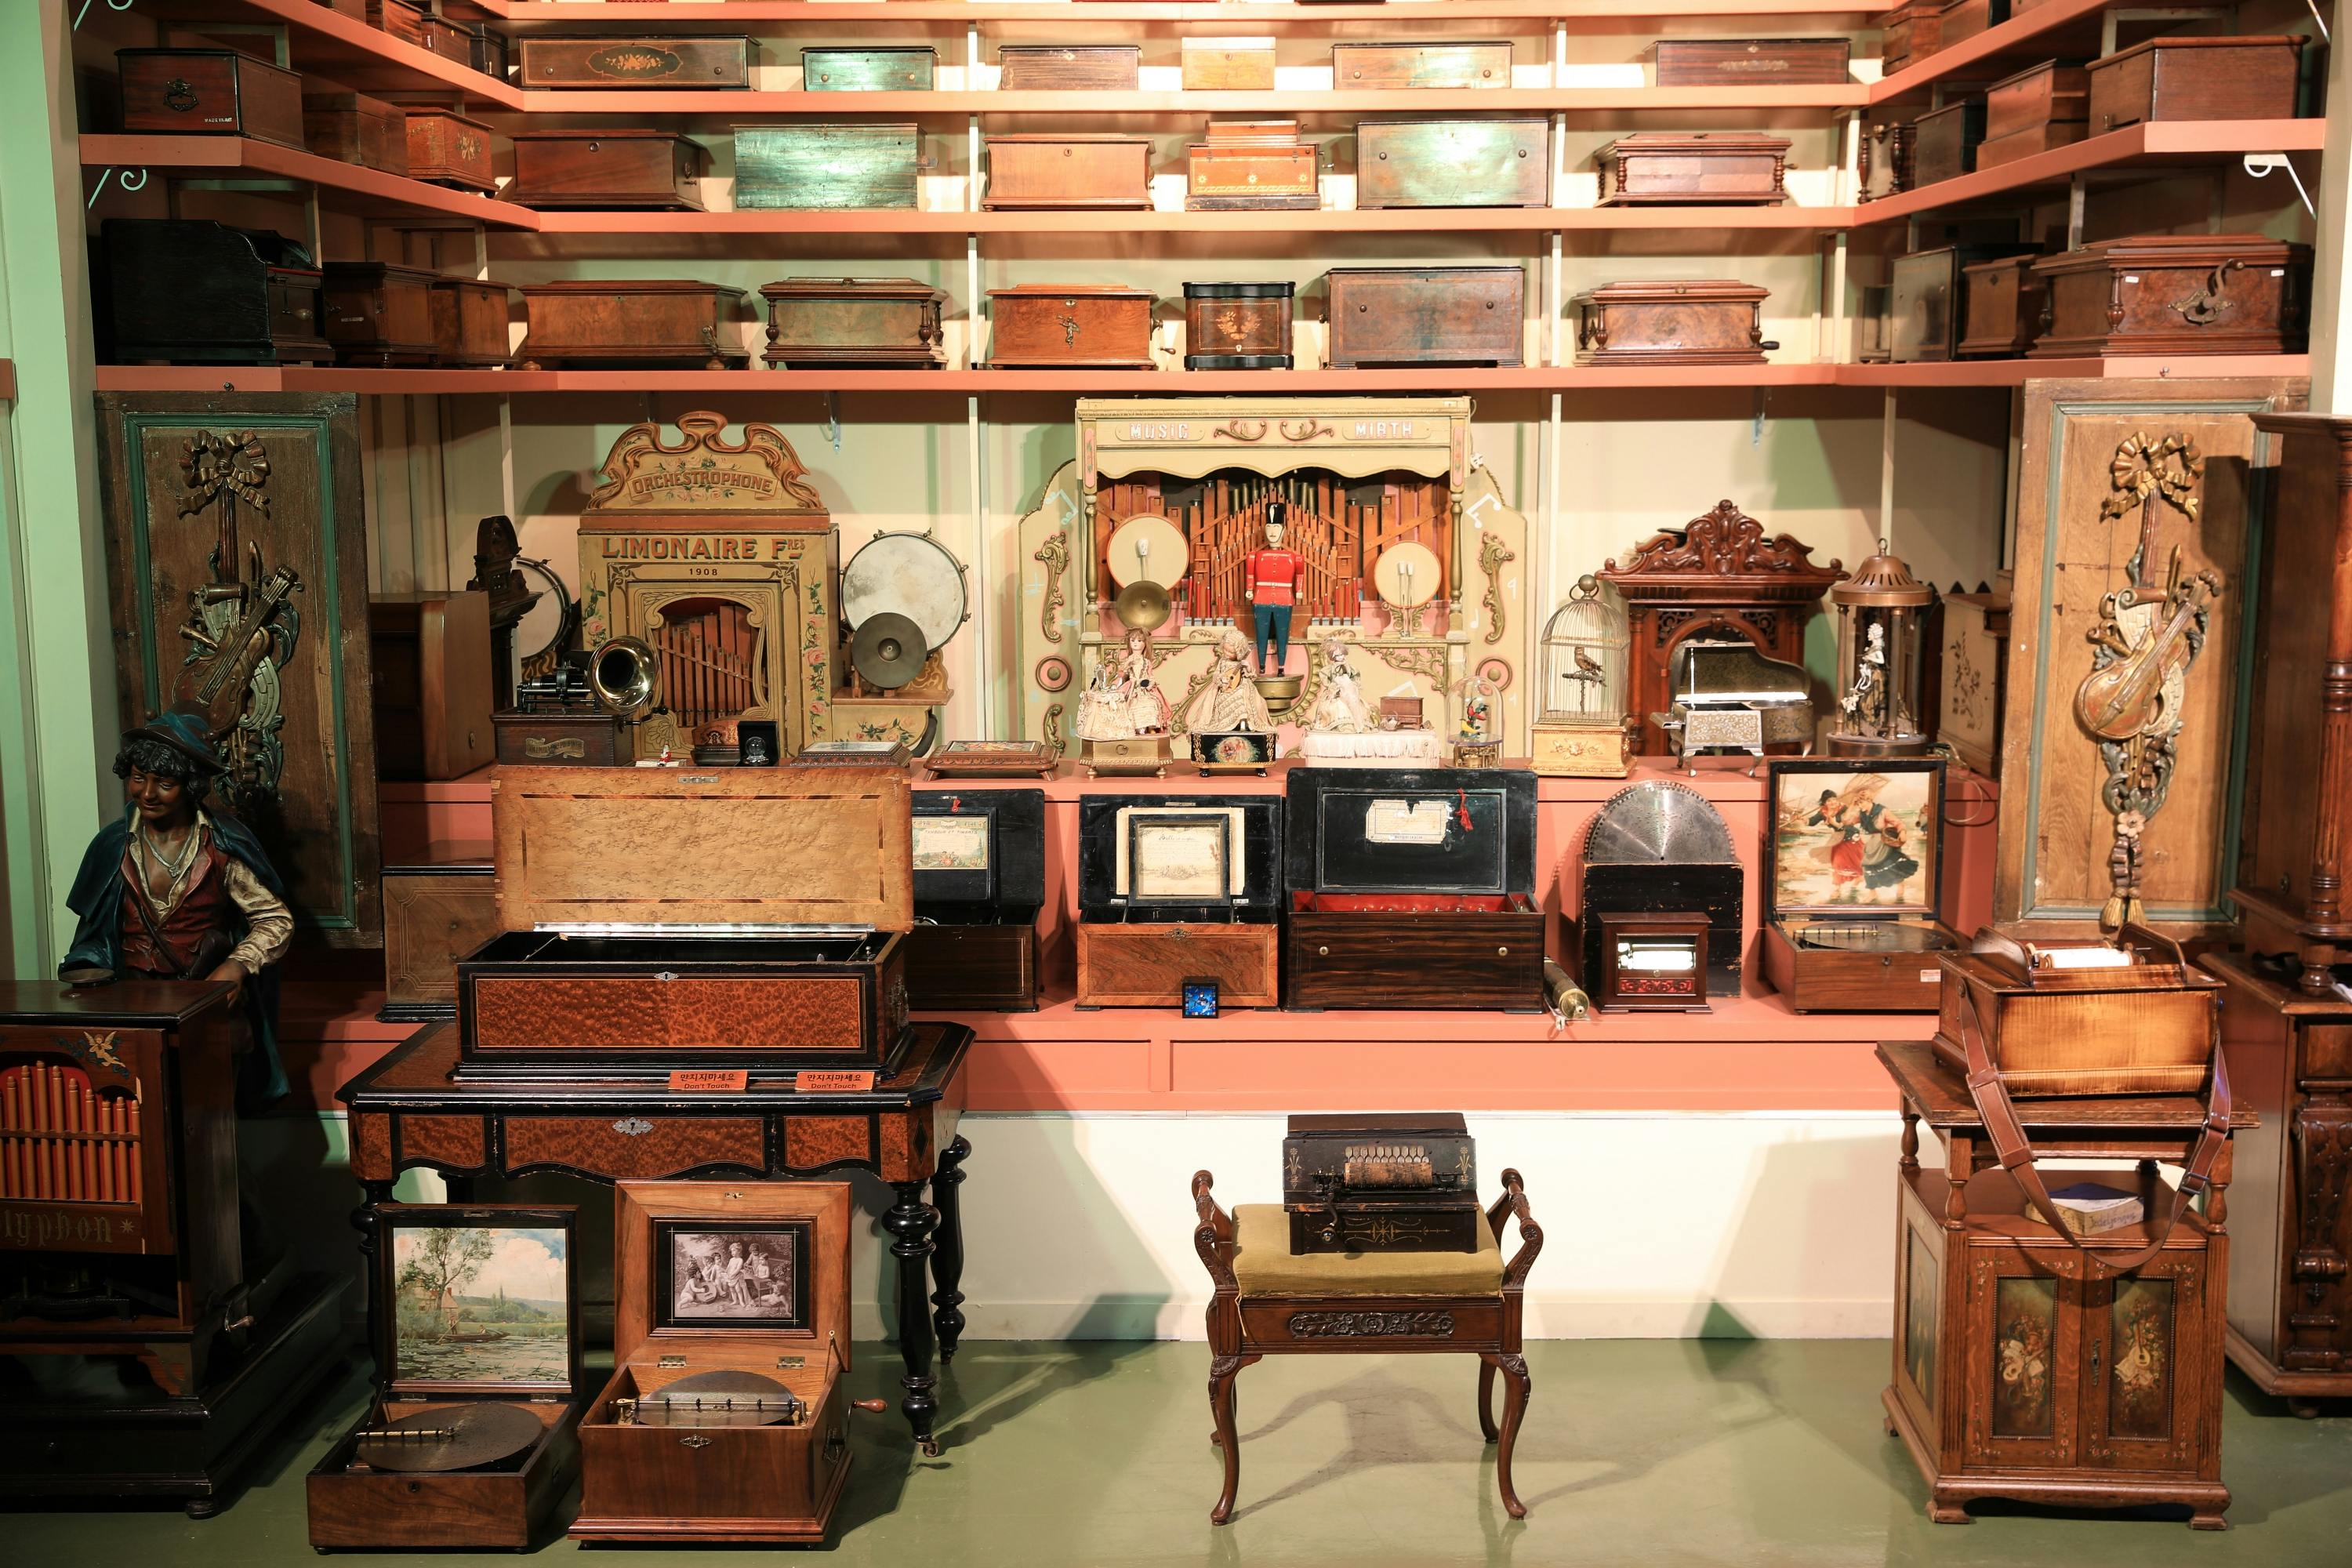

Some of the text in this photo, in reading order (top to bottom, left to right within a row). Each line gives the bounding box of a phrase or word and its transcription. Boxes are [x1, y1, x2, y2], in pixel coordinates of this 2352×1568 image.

[1129, 423, 1189, 439] MUSIC
[1355, 422, 1412, 439] MIRTH
[632, 470, 773, 492] ORCHESTROPHONE
[602, 538, 757, 559] LIMONAIRE
